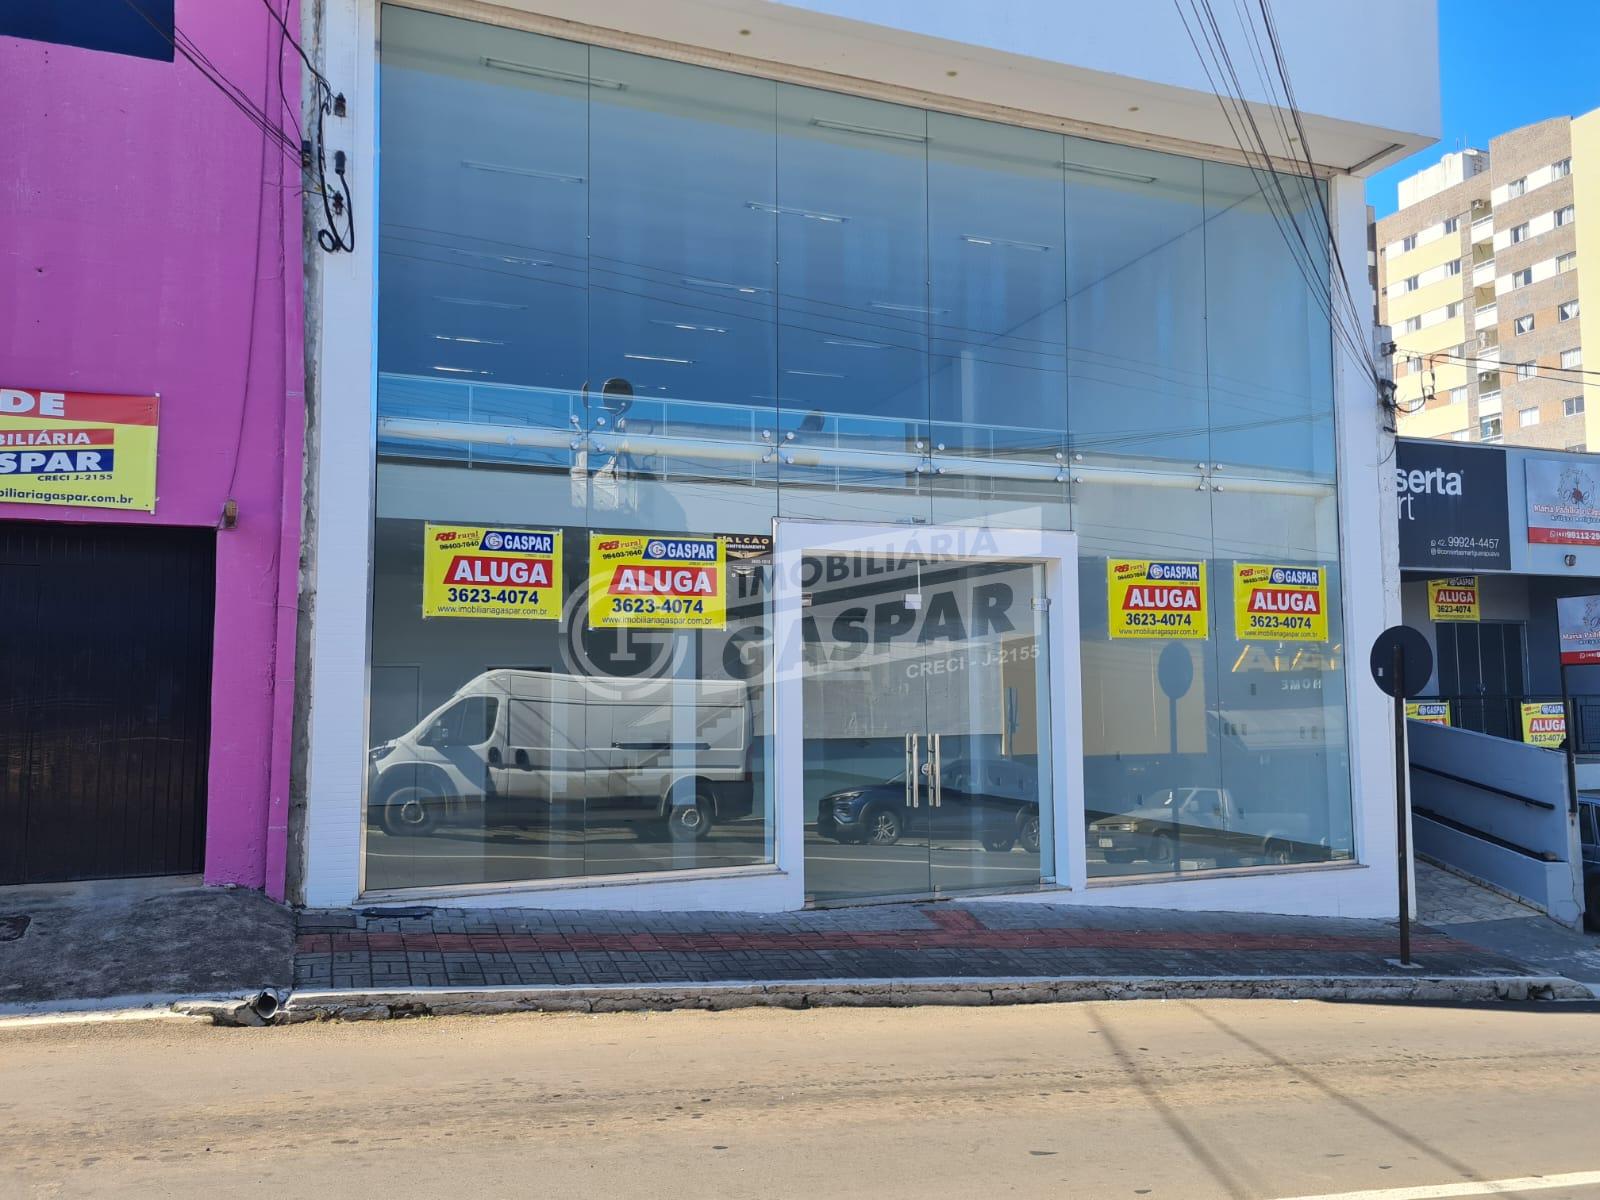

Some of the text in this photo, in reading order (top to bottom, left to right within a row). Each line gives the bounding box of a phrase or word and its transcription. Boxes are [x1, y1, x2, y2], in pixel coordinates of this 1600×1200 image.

[37, 473, 113, 482] CRECI J-2155
[504, 534, 551, 552] GASPAR
[1447, 536, 1500, 549] 99924-4457
[667, 542, 715, 560] GASPAR
[453, 559, 548, 585] ALUGA
[1163, 565, 1198, 579] GASPAR
[1285, 570, 1318, 584] GASPAR
[617, 568, 713, 593] ALUGA
[447, 588, 539, 605] 3623-4074
[1129, 588, 1198, 608] ALUGA
[1253, 591, 1317, 612] ALUGA
[1438, 590, 1474, 603] ALUGA
[437, 605, 548, 617] www.imobiliariagaspar.com.br
[612, 598, 704, 614] 3623-4074
[602, 615, 713, 627] www.imobiliariagaspar.com.br
[1126, 613, 1192, 626] 3623-4074
[1250, 615, 1312, 629] 3623-4074
